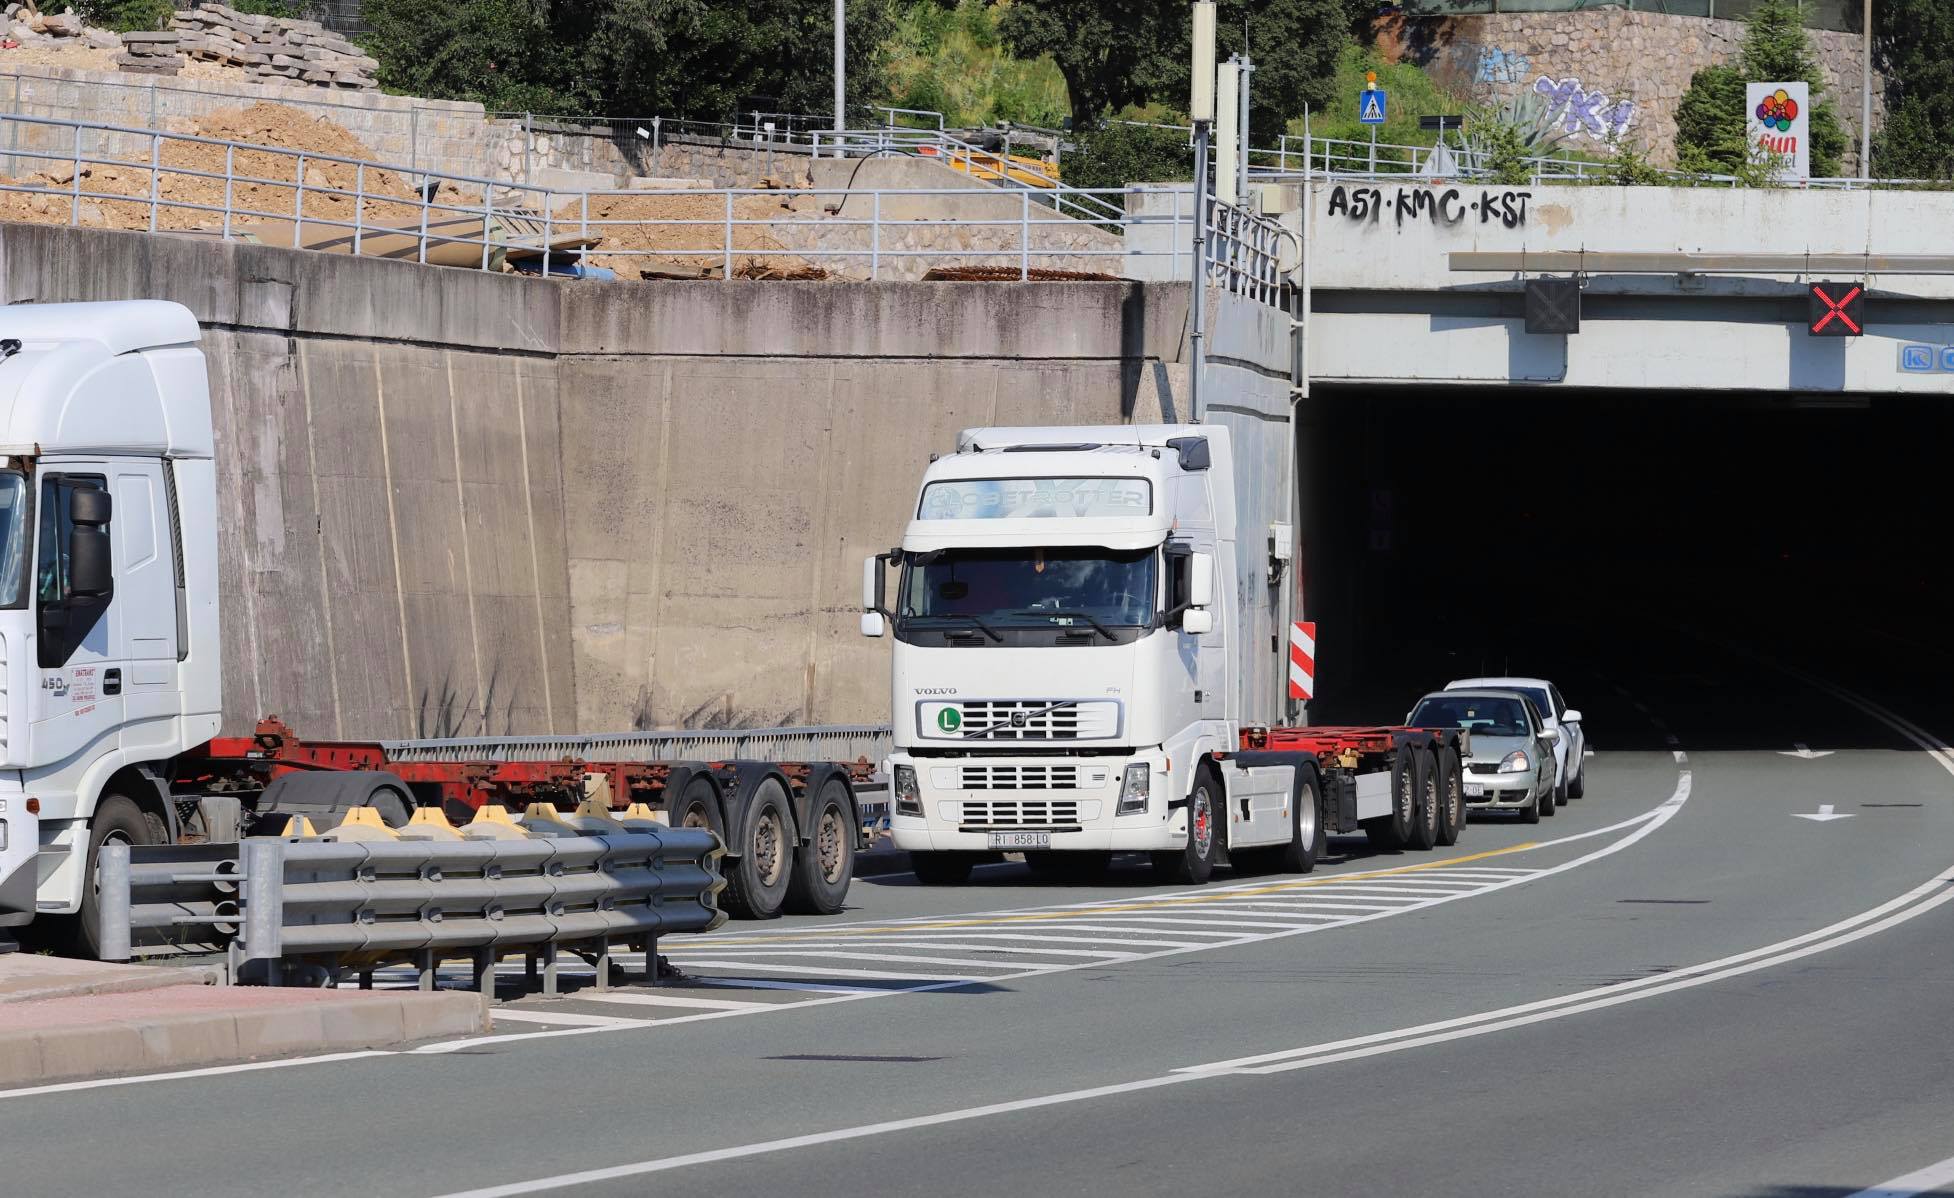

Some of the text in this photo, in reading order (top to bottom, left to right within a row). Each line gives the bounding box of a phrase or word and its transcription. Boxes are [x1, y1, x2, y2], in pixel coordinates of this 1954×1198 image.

[914, 687, 958, 695] VOLVO
[943, 711, 955, 729] L
[995, 833, 1006, 845] RI
